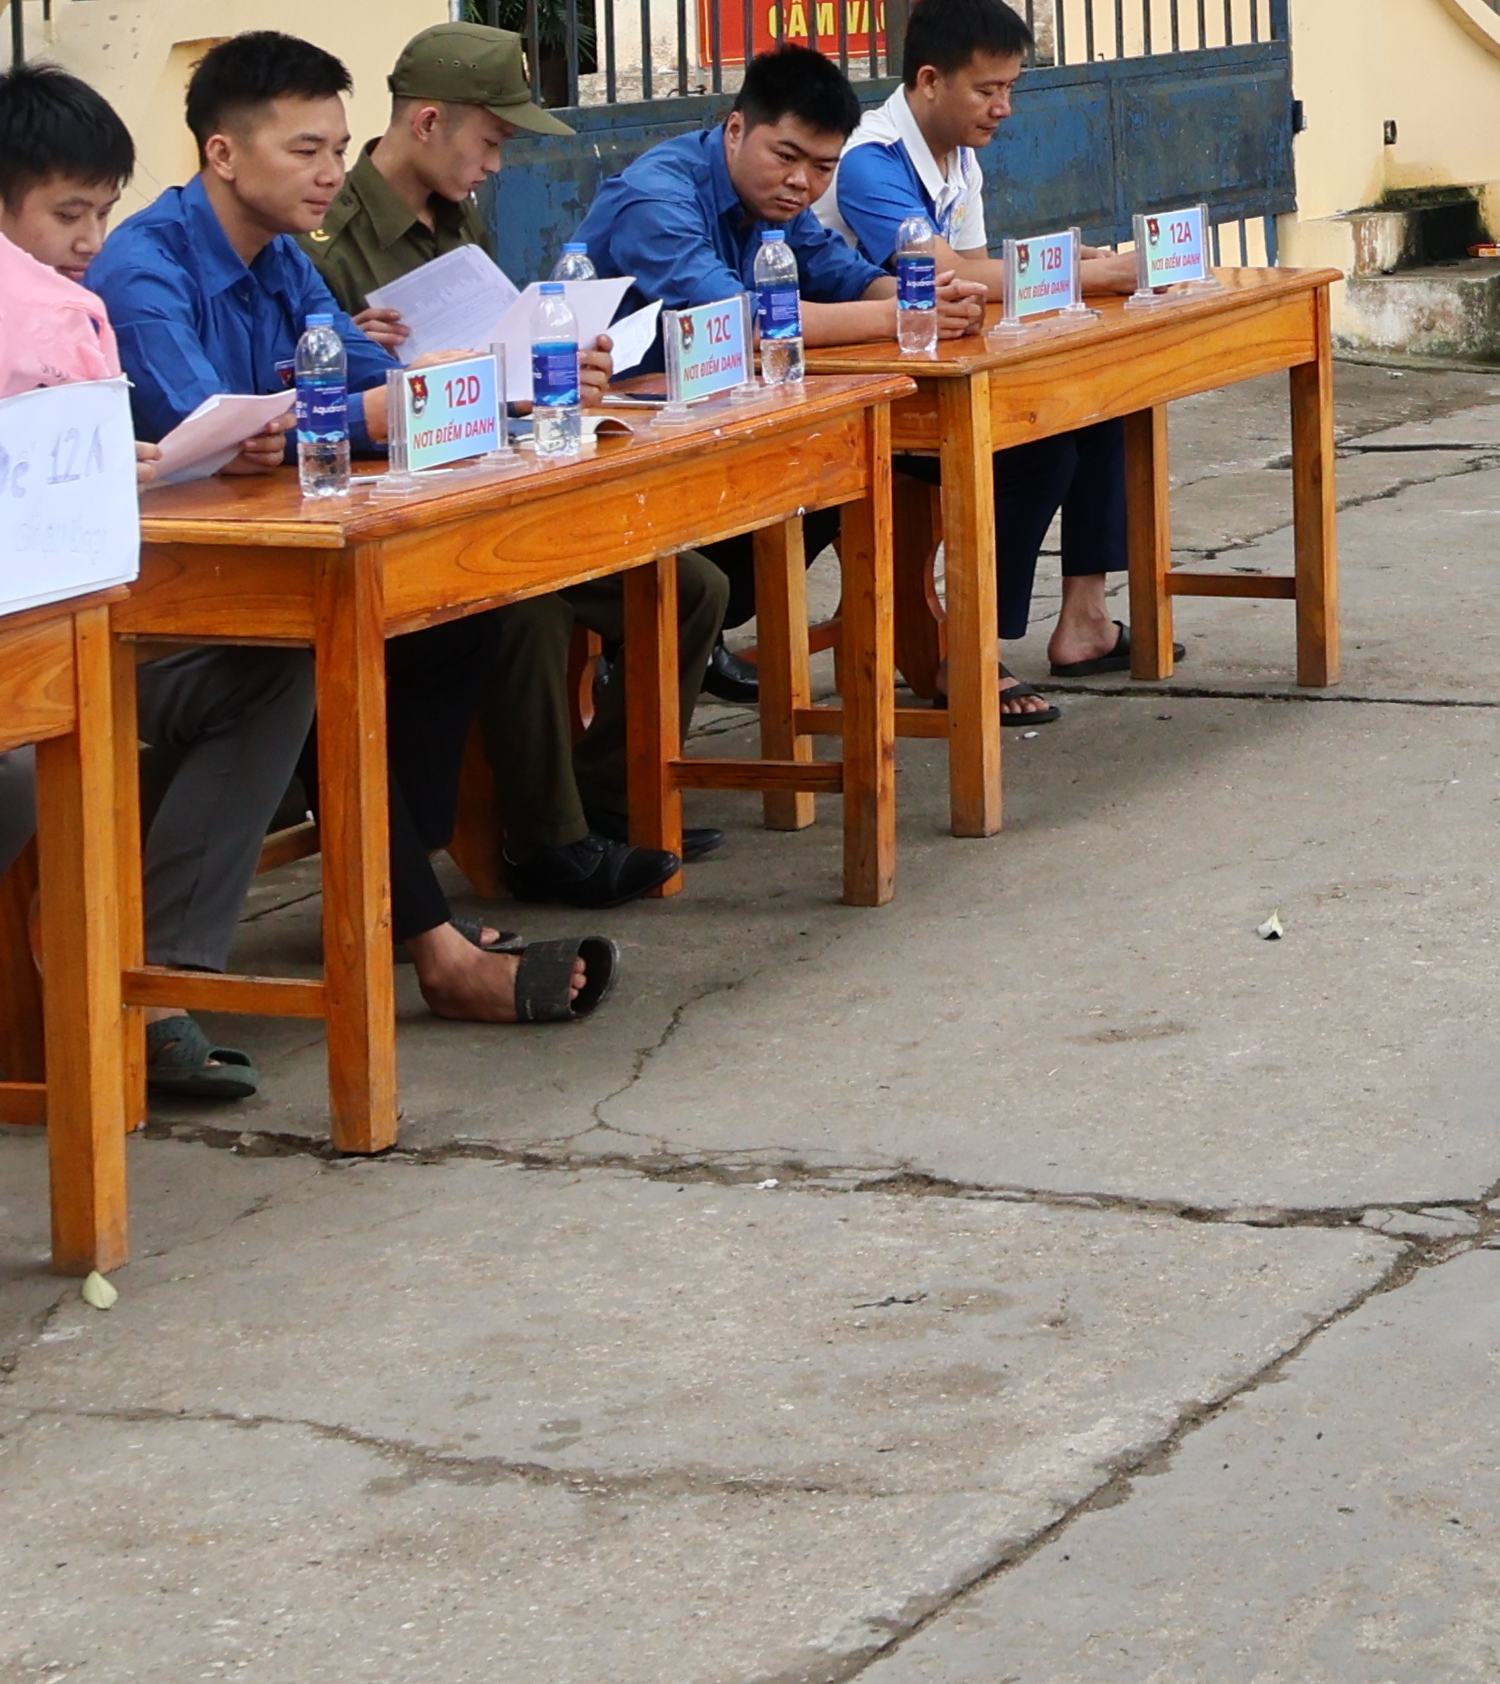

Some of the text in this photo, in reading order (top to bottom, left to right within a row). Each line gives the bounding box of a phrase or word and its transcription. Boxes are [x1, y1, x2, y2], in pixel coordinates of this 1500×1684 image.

[1169, 221, 1192, 244] 12A
[1040, 246, 1062, 271] 12B
[706, 314, 731, 345] 12C
[721, 352, 742, 372] DANH
[444, 375, 481, 408] 12D
[413, 416, 495, 450] NƠI ĐIỂM DANH
[47, 426, 105, 485] 12A
